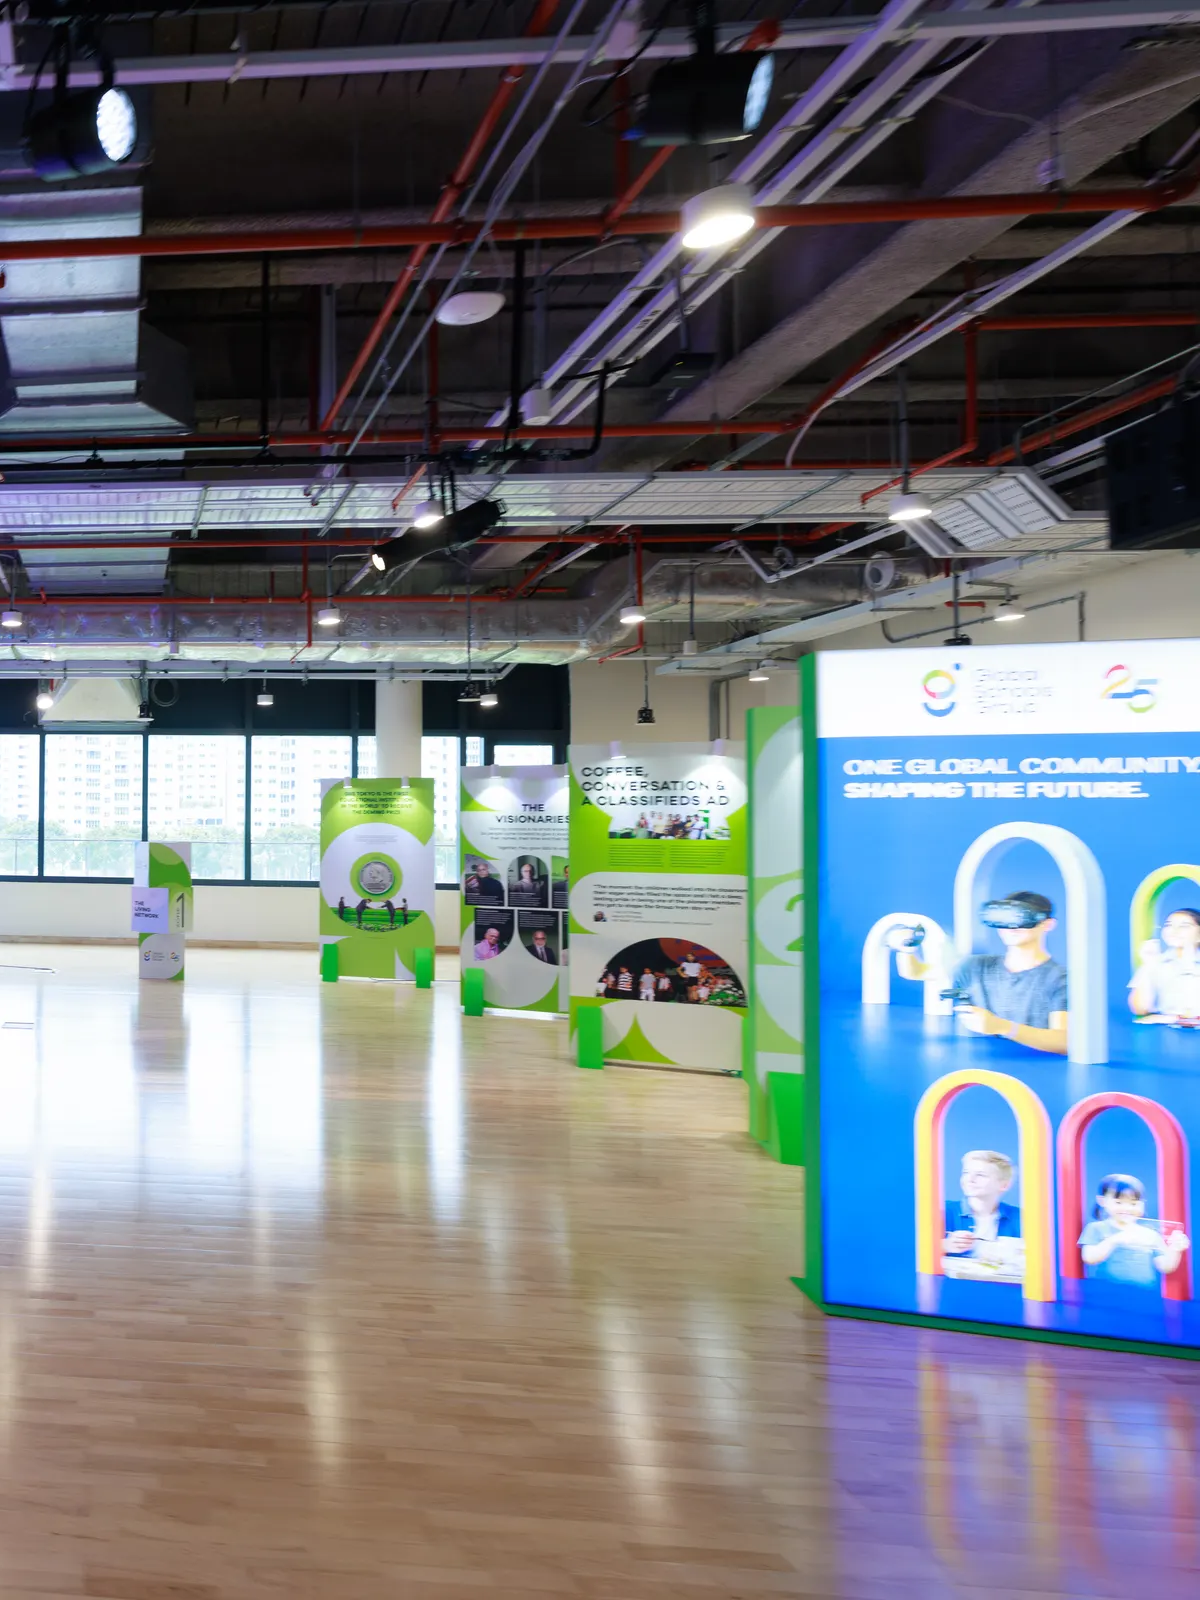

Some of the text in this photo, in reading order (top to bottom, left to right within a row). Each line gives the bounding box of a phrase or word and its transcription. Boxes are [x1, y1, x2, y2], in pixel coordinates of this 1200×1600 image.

[842, 759, 903, 775] ONE
[904, 758, 1018, 775] GLOBAL
[581, 767, 649, 777] COFFEE,
[581, 781, 726, 791] CONVERSATION &
[842, 782, 1150, 798] SHAPING THE FUTURE.
[581, 795, 730, 806] A CLASSIFIEDS AD
[521, 803, 545, 812] THE
[496, 815, 570, 824] VISIONARIES
[176, 892, 185, 928] 1
